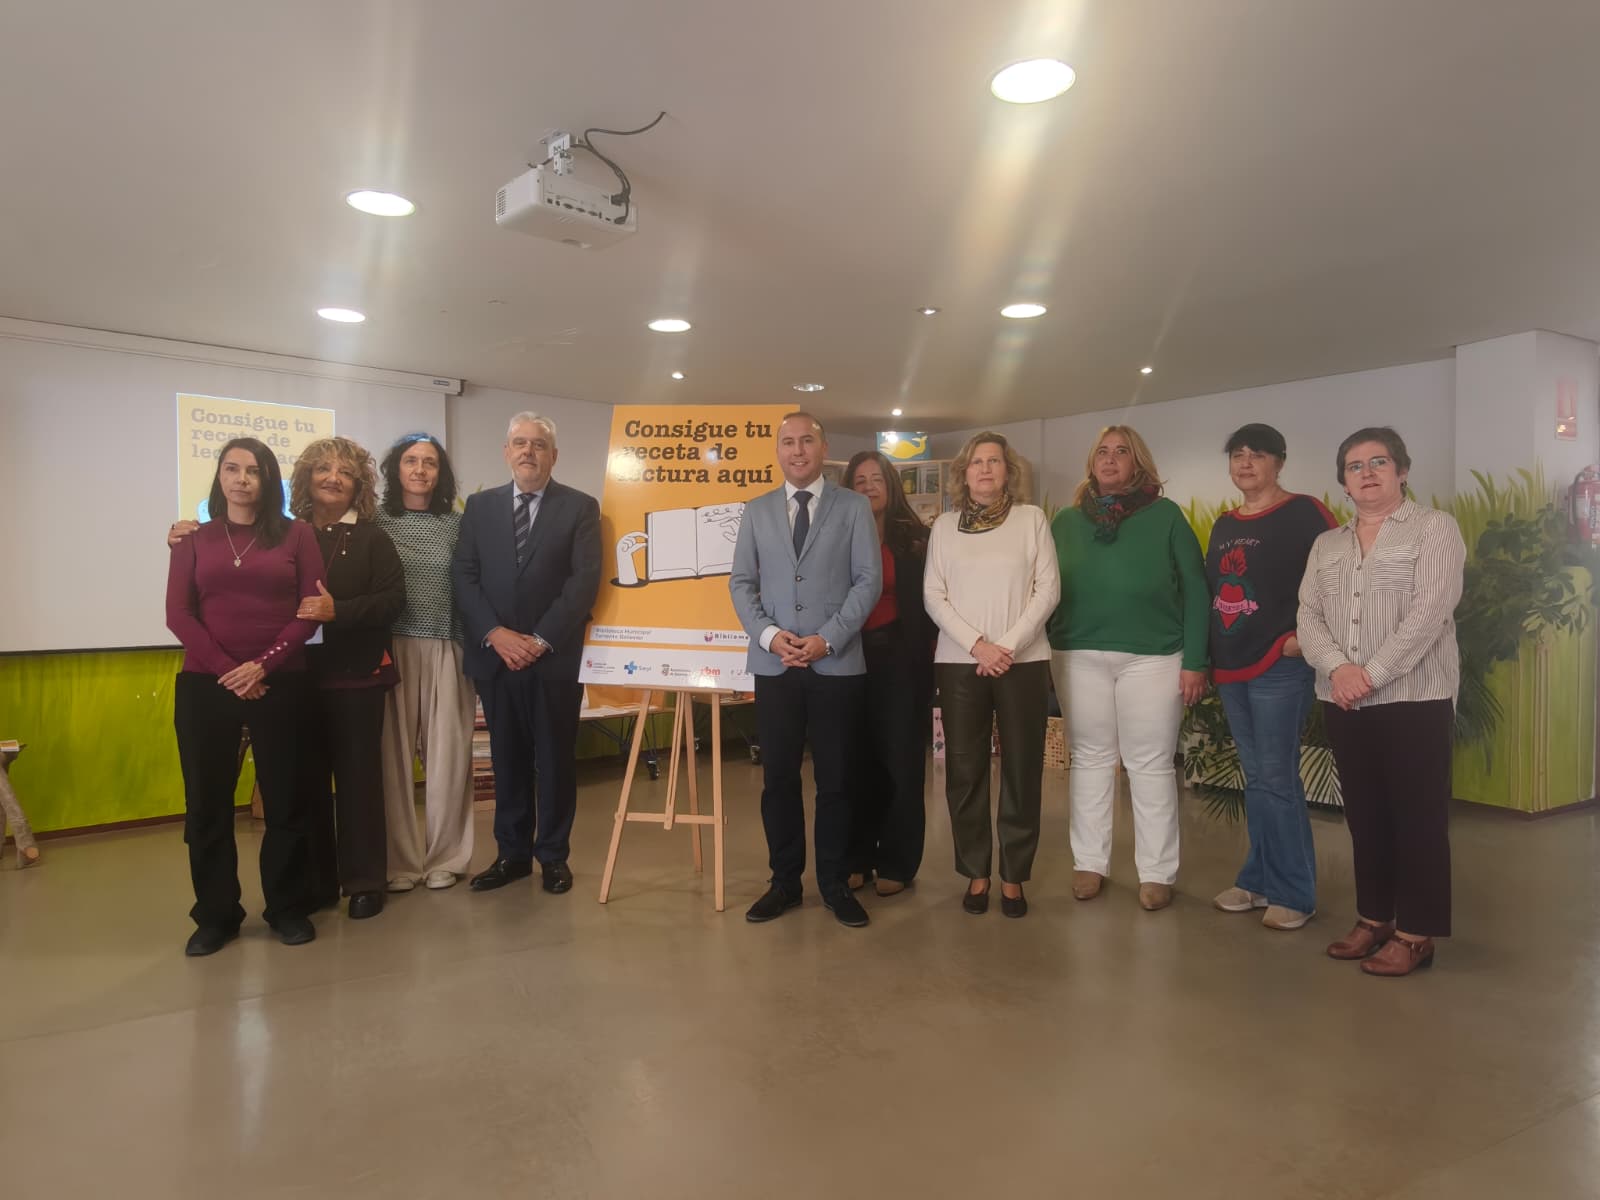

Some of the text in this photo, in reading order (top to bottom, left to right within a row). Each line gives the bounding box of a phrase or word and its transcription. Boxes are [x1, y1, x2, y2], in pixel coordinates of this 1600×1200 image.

[191, 408, 316, 433] Consigue tu
[625, 420, 772, 442] Consigue tu
[267, 433, 290, 447] de
[616, 464, 773, 487] ctura aquí
